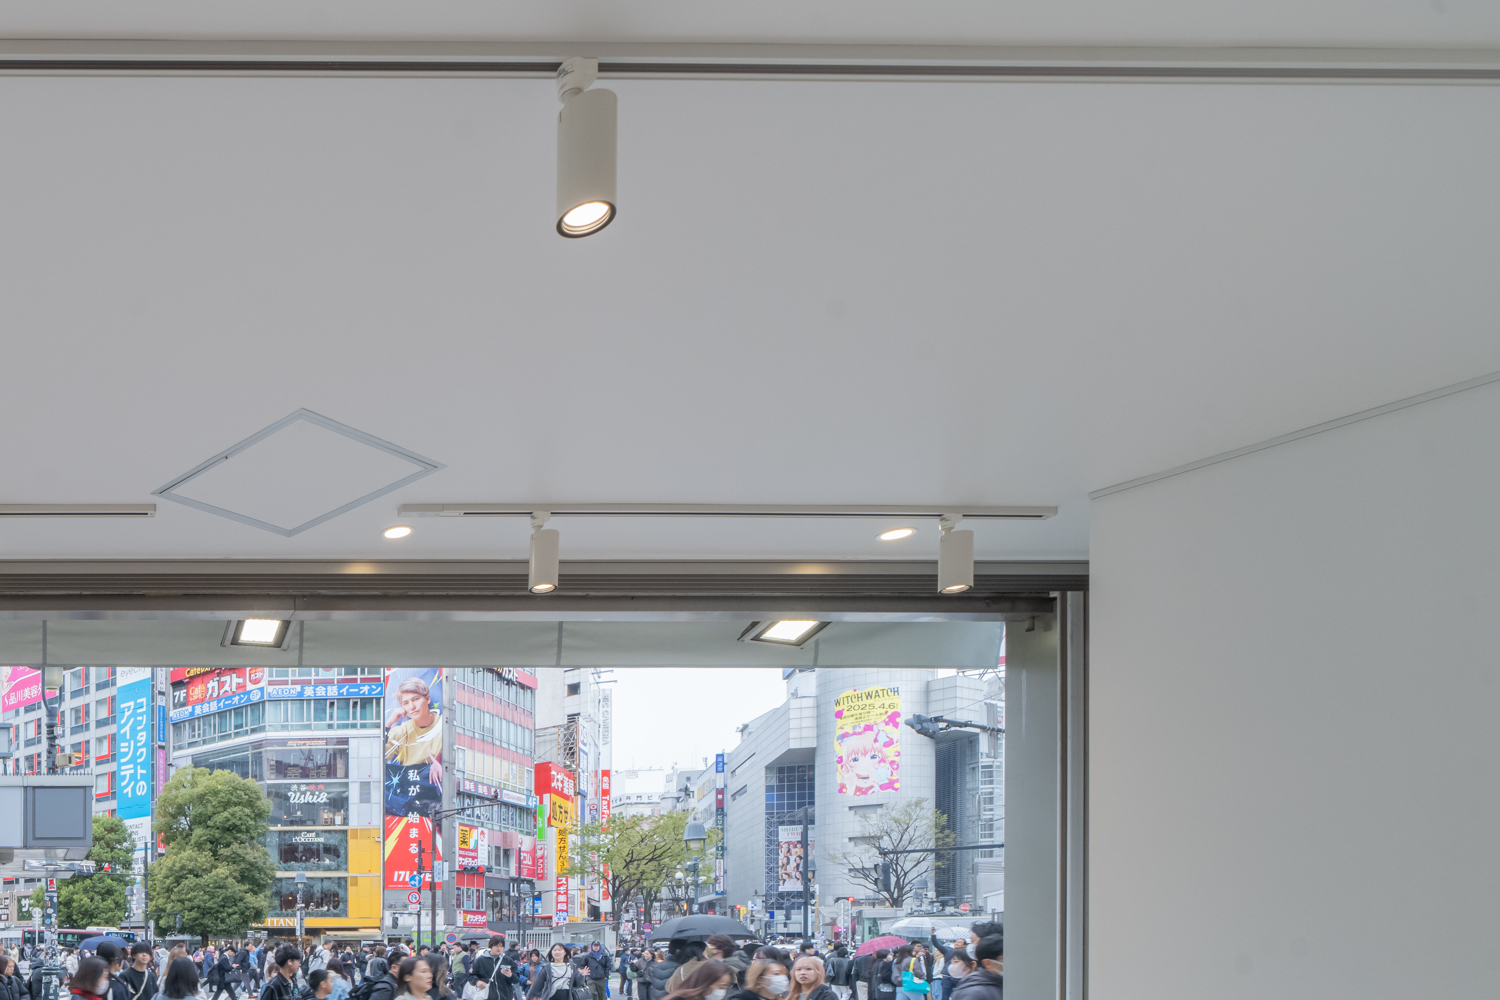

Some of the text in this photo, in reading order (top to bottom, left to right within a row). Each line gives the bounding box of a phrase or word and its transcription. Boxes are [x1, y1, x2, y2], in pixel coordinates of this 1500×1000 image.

[206, 673, 243, 700] ガスト
[271, 687, 297, 697] AEON
[304, 685, 381, 697] 英会話イーオン
[174, 690, 186, 703] 7F
[251, 690, 260, 700] 6F
[834, 692, 863, 707] WITCH
[864, 687, 899, 700] WATCH
[194, 694, 247, 715] 英会話イーオン
[847, 703, 895, 711] 2025.4.6
[173, 707, 189, 720] AEON
[121, 701, 134, 798] アイシティ
[137, 697, 147, 796] コンタクトの
[551, 770, 574, 798] スギ薬局
[288, 791, 329, 803] Ushi8
[528, 797, 536, 808] 4F
[408, 769, 420, 863] 私が、始まる。
[552, 800, 572, 826] 処方せ
[393, 871, 432, 882] 17LE
[557, 878, 567, 910] スギ薬局
